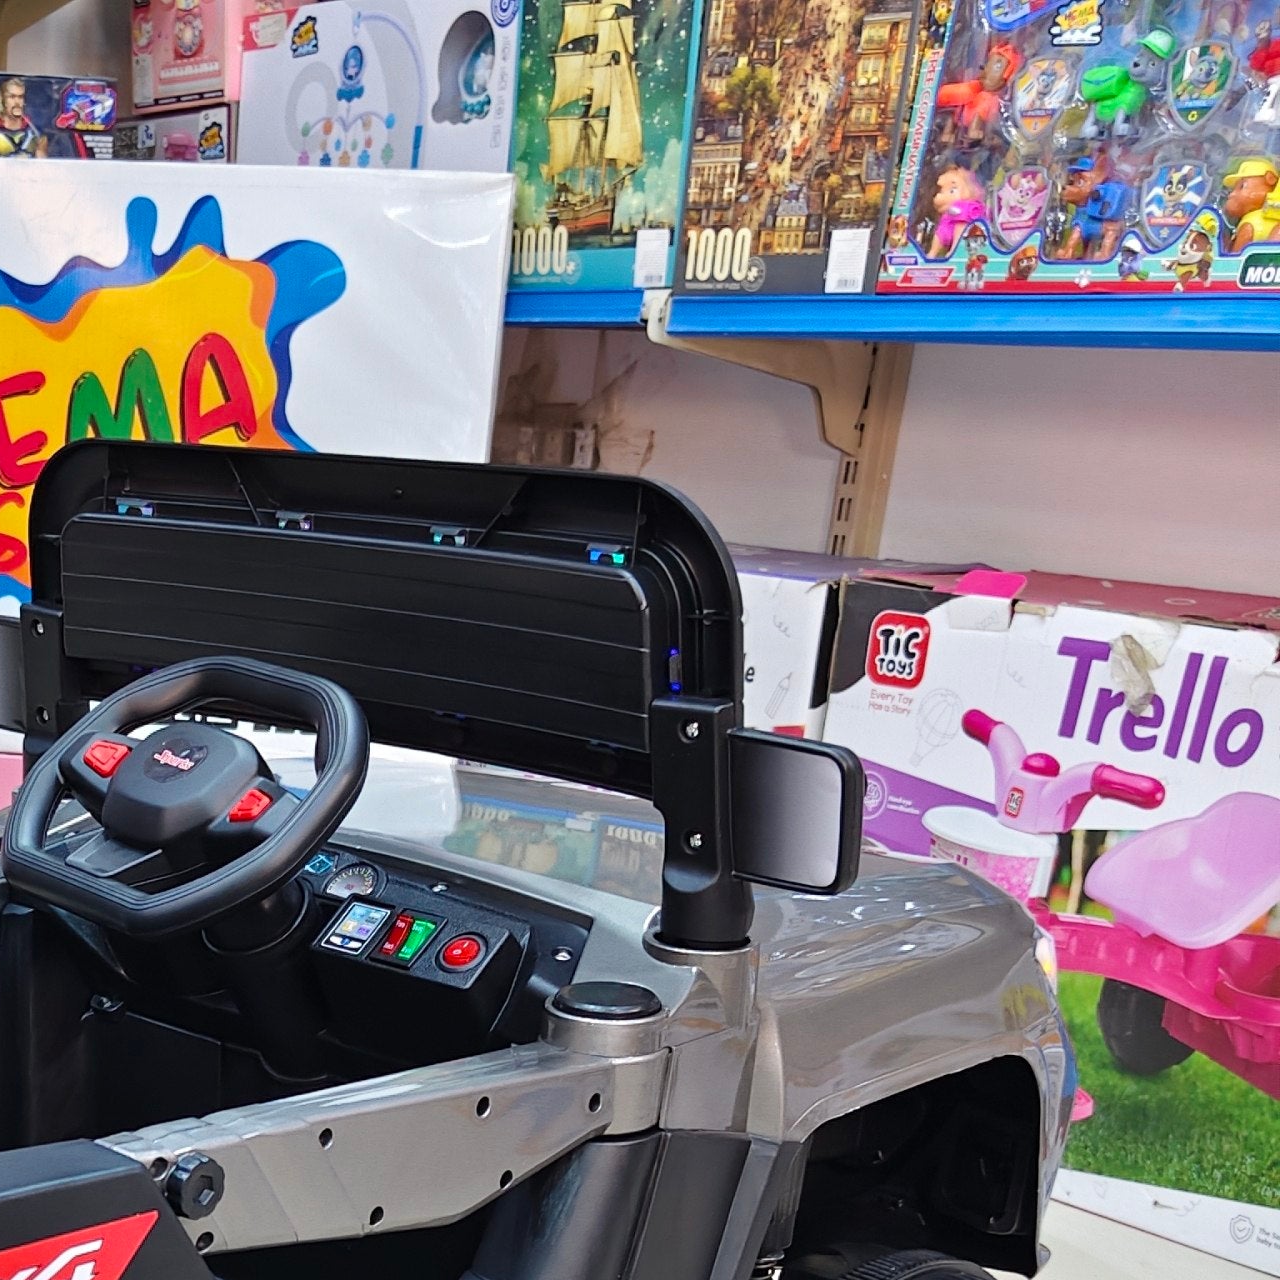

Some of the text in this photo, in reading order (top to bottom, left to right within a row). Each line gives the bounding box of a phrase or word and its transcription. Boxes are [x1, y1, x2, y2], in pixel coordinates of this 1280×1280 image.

[685, 227, 752, 282] 1000
[877, 656, 914, 676] TOYS
[1057, 636, 1264, 767] Trello
